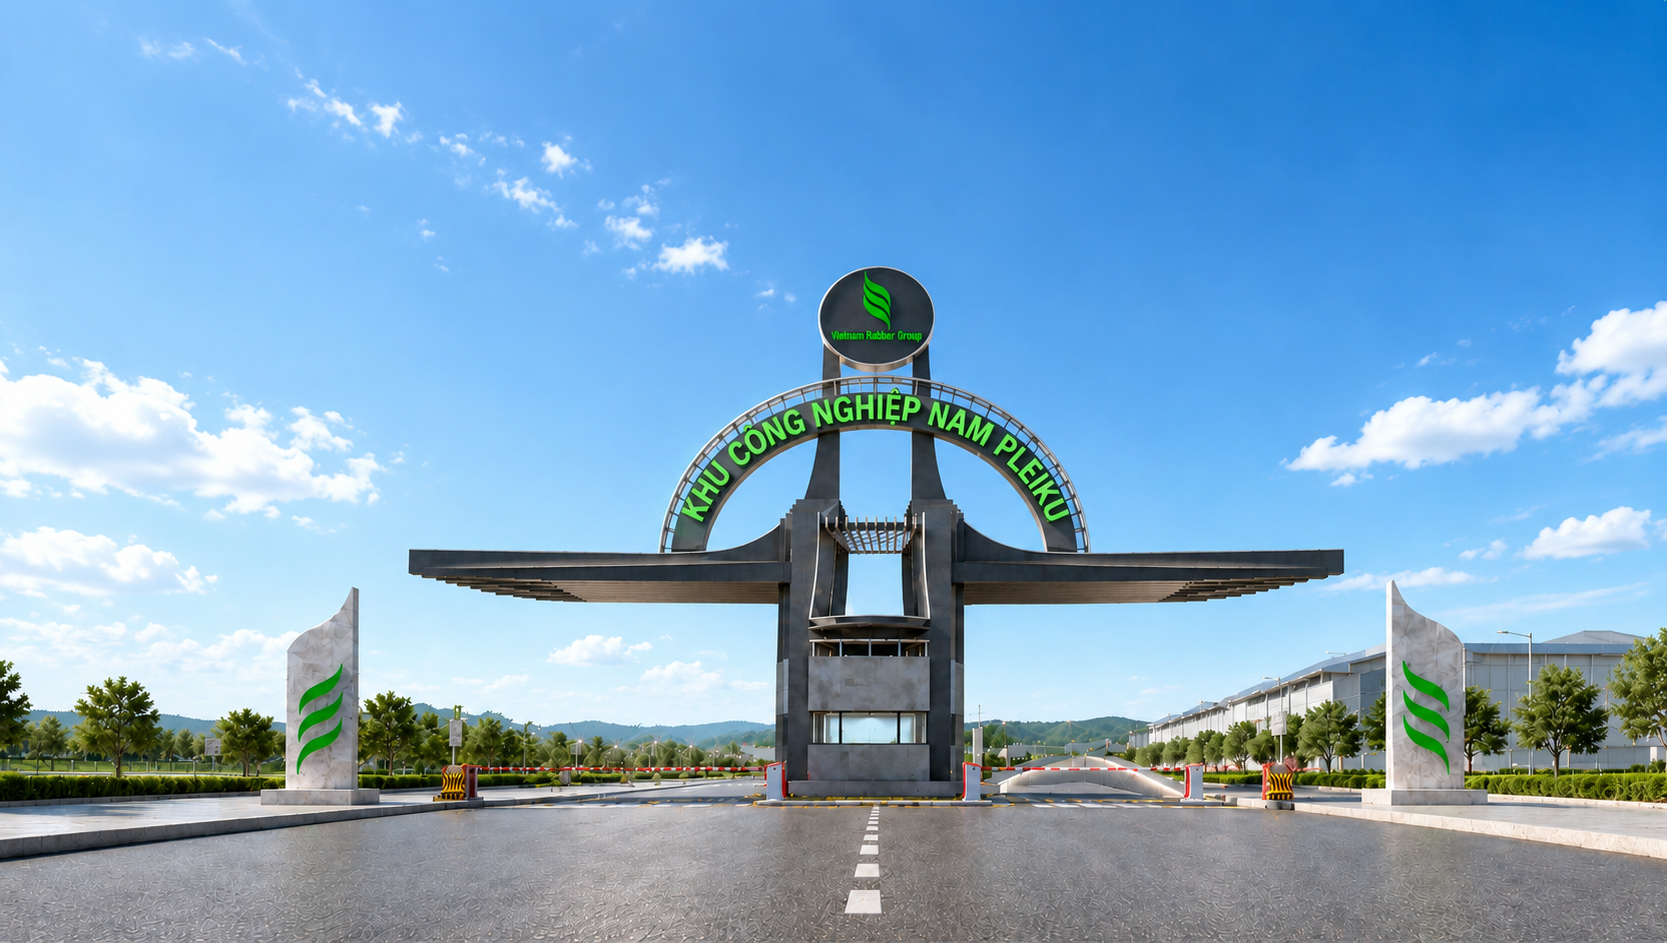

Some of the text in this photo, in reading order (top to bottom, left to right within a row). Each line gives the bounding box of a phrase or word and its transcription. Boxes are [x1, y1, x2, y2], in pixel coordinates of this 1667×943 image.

[831, 330, 923, 343] Vietnam Rubber Group
[681, 387, 1070, 523] KHU CÔNG NGHIỆP NAM PLEIKU
